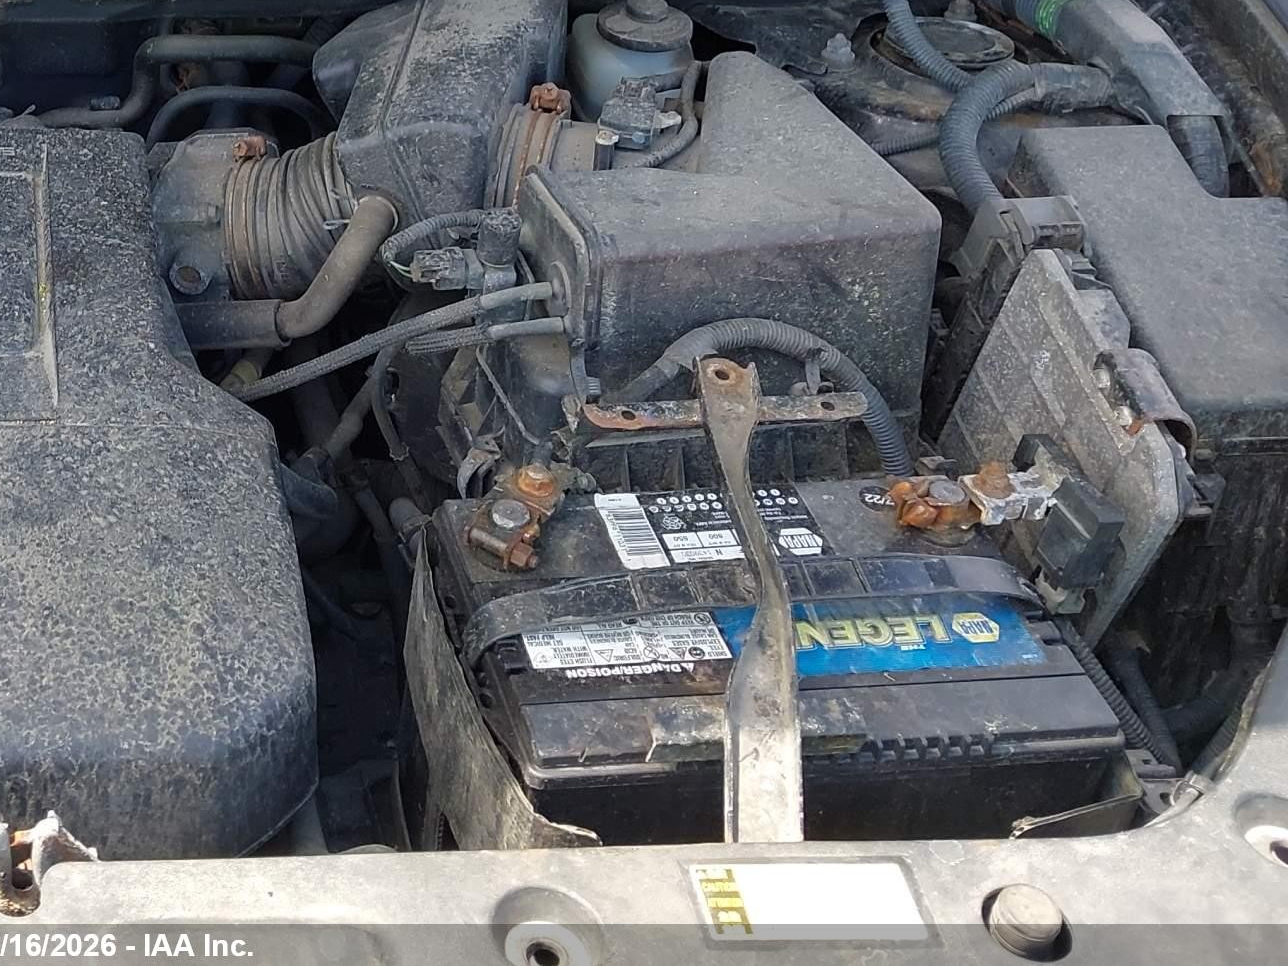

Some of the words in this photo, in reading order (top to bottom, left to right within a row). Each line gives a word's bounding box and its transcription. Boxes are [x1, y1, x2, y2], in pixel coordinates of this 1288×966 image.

[783, 534, 814, 547] NAPA
[794, 614, 952, 649] LEGEN
[958, 619, 993, 635] NAPA
[566, 663, 680, 678] DANGER/POISON
